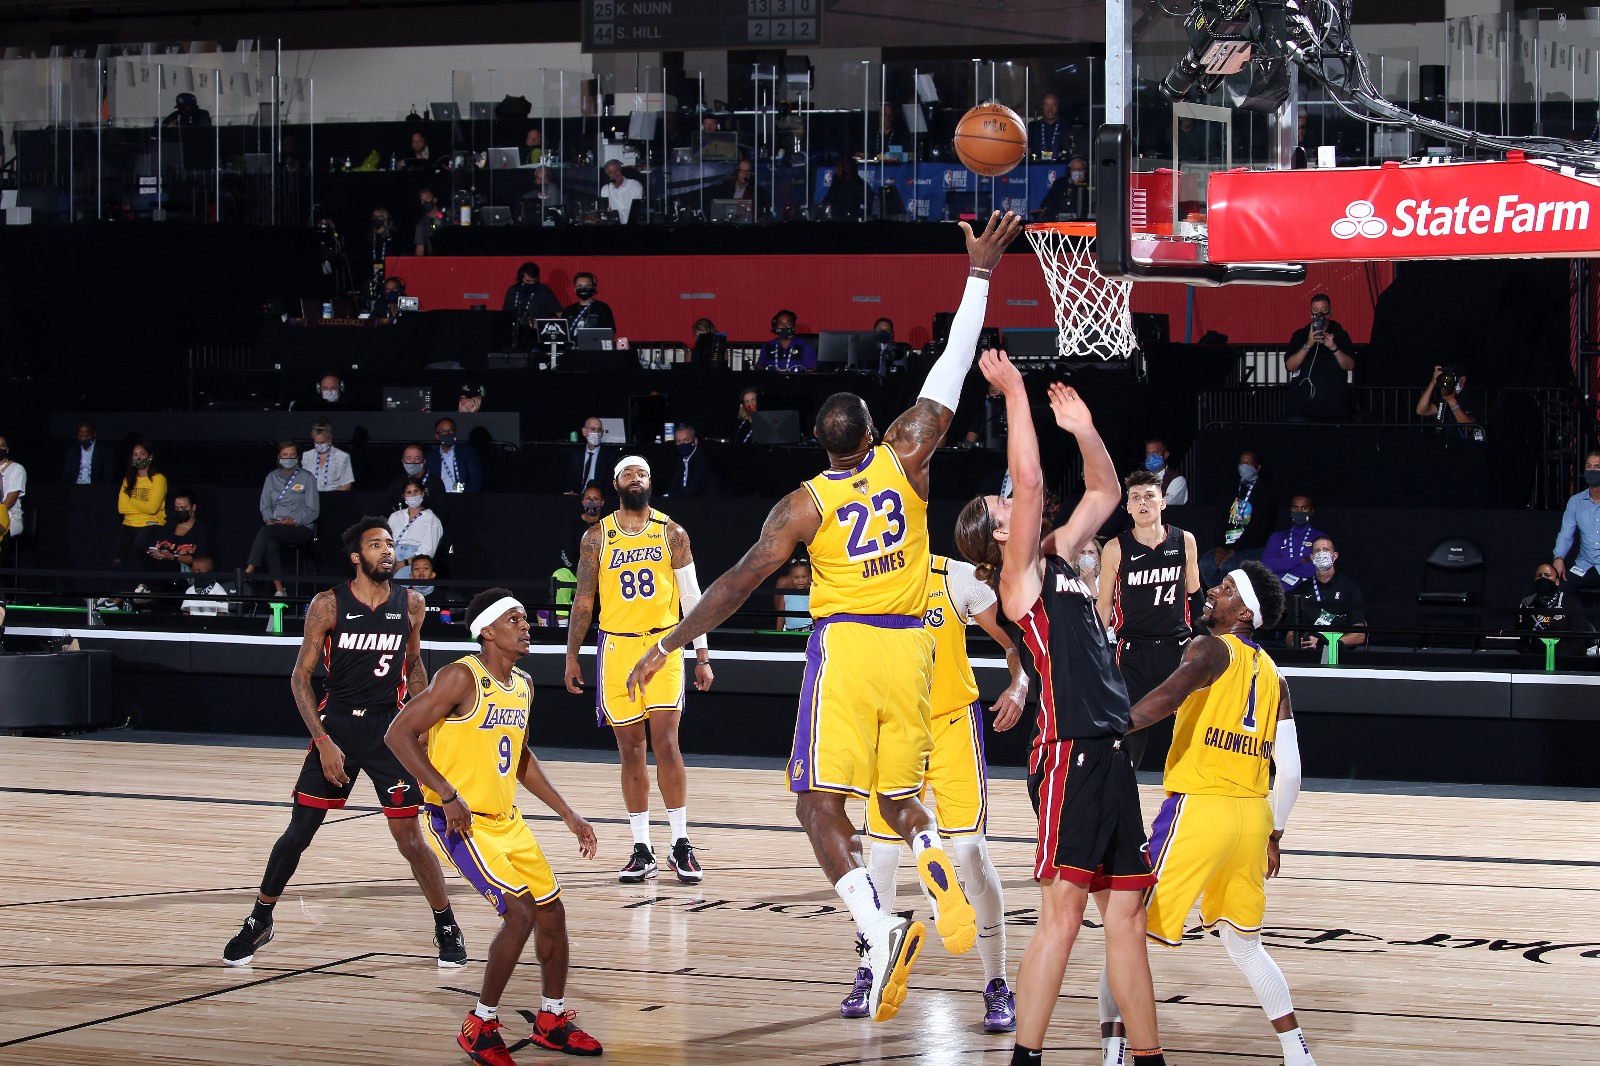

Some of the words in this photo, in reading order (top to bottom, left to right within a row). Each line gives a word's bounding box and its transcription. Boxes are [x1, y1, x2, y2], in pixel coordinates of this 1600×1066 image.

[596, 4, 613, 17] 25
[617, 3, 629, 15] K.
[633, 2, 672, 15] NUNN
[596, 27, 613, 40] 44
[617, 27, 629, 39] S.
[633, 26, 661, 39] HILL
[754, 24, 763, 36] 2
[777, 24, 786, 36] 2
[801, 23, 809, 36] 2
[836, 488, 908, 562] 23
[608, 546, 663, 570] LAKERS
[862, 550, 905, 579] JAMES
[619, 567, 656, 601] 88
[1127, 565, 1182, 586] MIAMI
[1153, 584, 1177, 606] 14
[337, 632, 403, 651] MIAMI
[373, 654, 394, 677] 5
[1242, 673, 1257, 732] 1
[478, 703, 527, 730] LAKERS
[498, 735, 512, 776] 9
